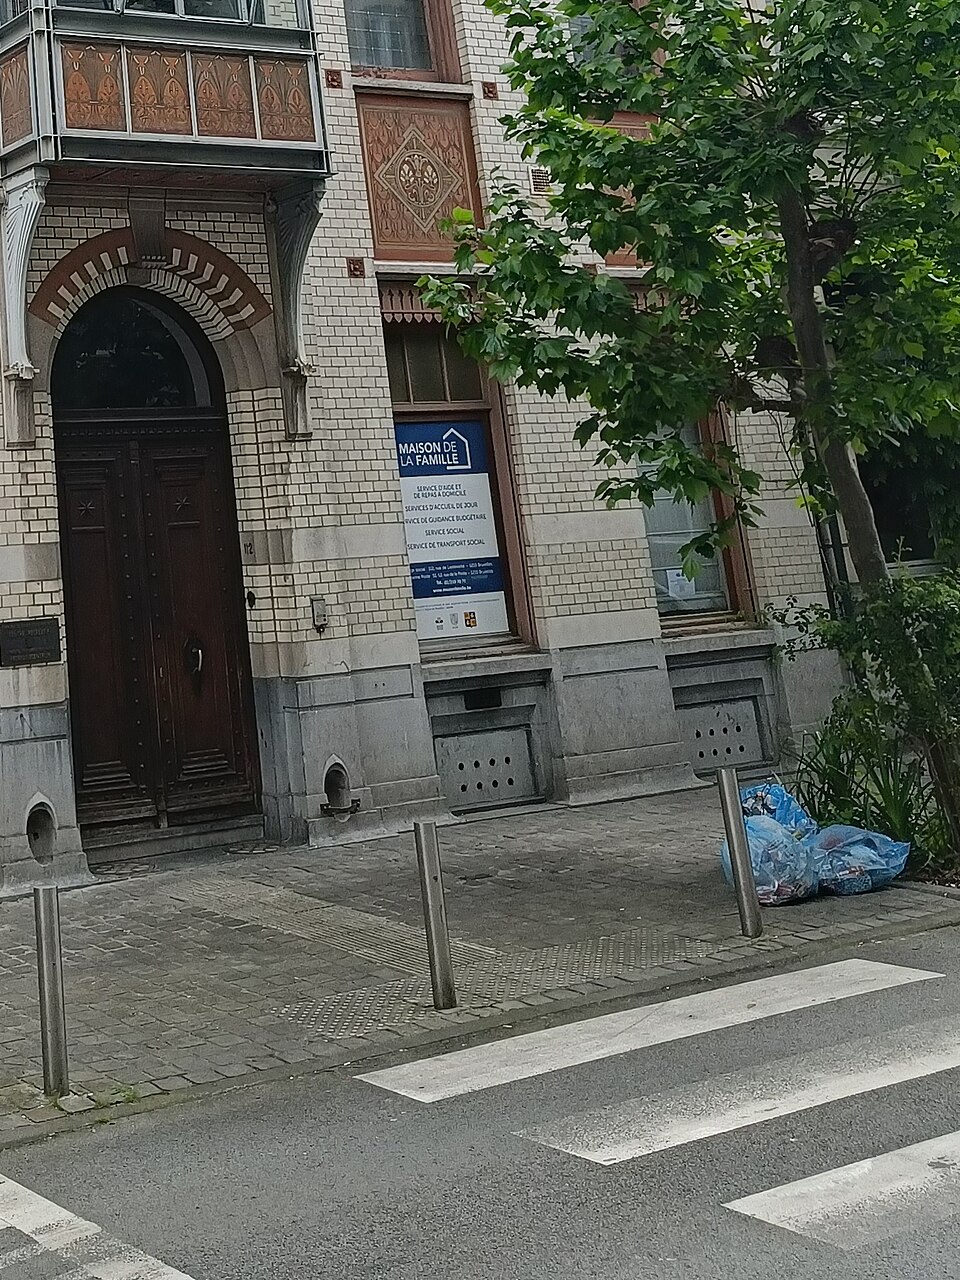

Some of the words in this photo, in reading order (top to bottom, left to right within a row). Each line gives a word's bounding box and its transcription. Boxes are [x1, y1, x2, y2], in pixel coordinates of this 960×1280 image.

[398, 442, 441, 454] MAISON
[443, 441, 457, 452] DE
[400, 455, 414, 466] LA
[416, 454, 459, 465] FAMILLE
